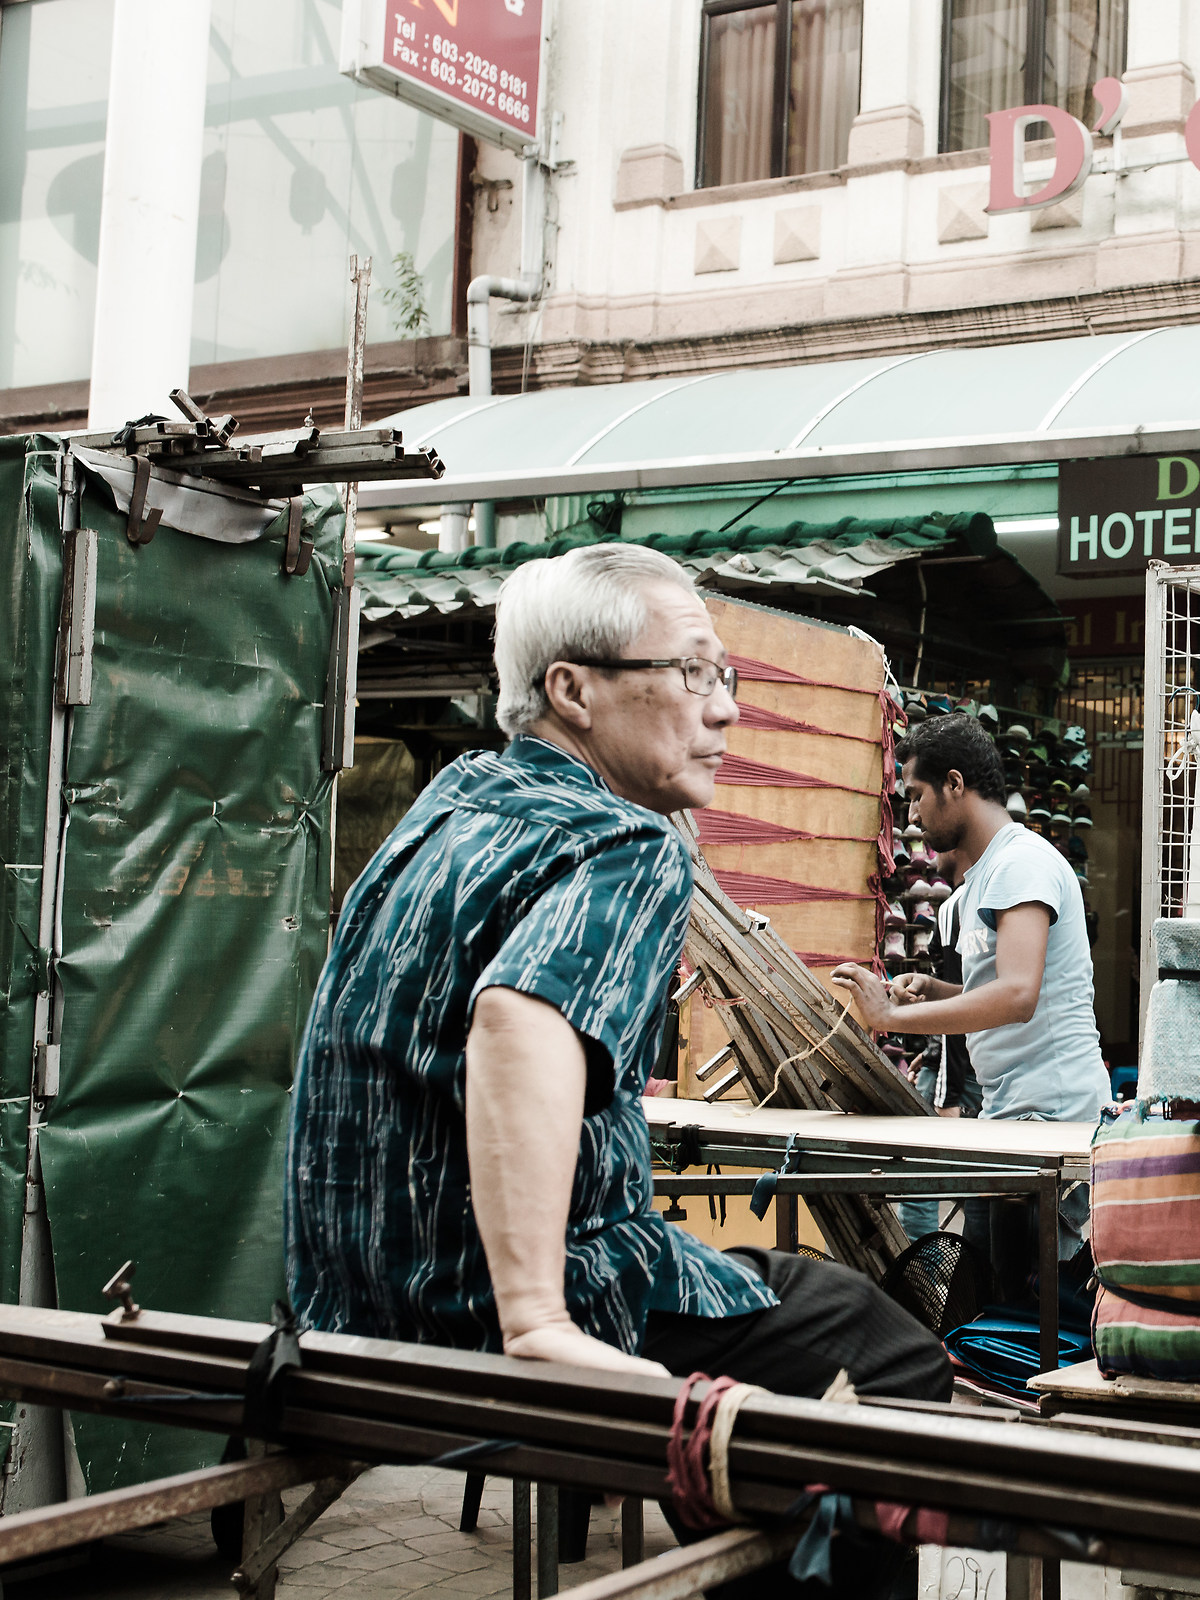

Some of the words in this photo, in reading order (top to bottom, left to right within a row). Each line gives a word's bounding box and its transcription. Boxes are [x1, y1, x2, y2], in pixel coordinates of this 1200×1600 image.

[393, 37, 419, 67] Fax
[430, 57, 496, 106] 603-2072
[498, 92, 530, 123] 6666
[394, 13, 416, 41] Tel
[432, 34, 498, 83] 603-2026
[500, 69, 527, 99] 8181
[984, 77, 1127, 214] D'
